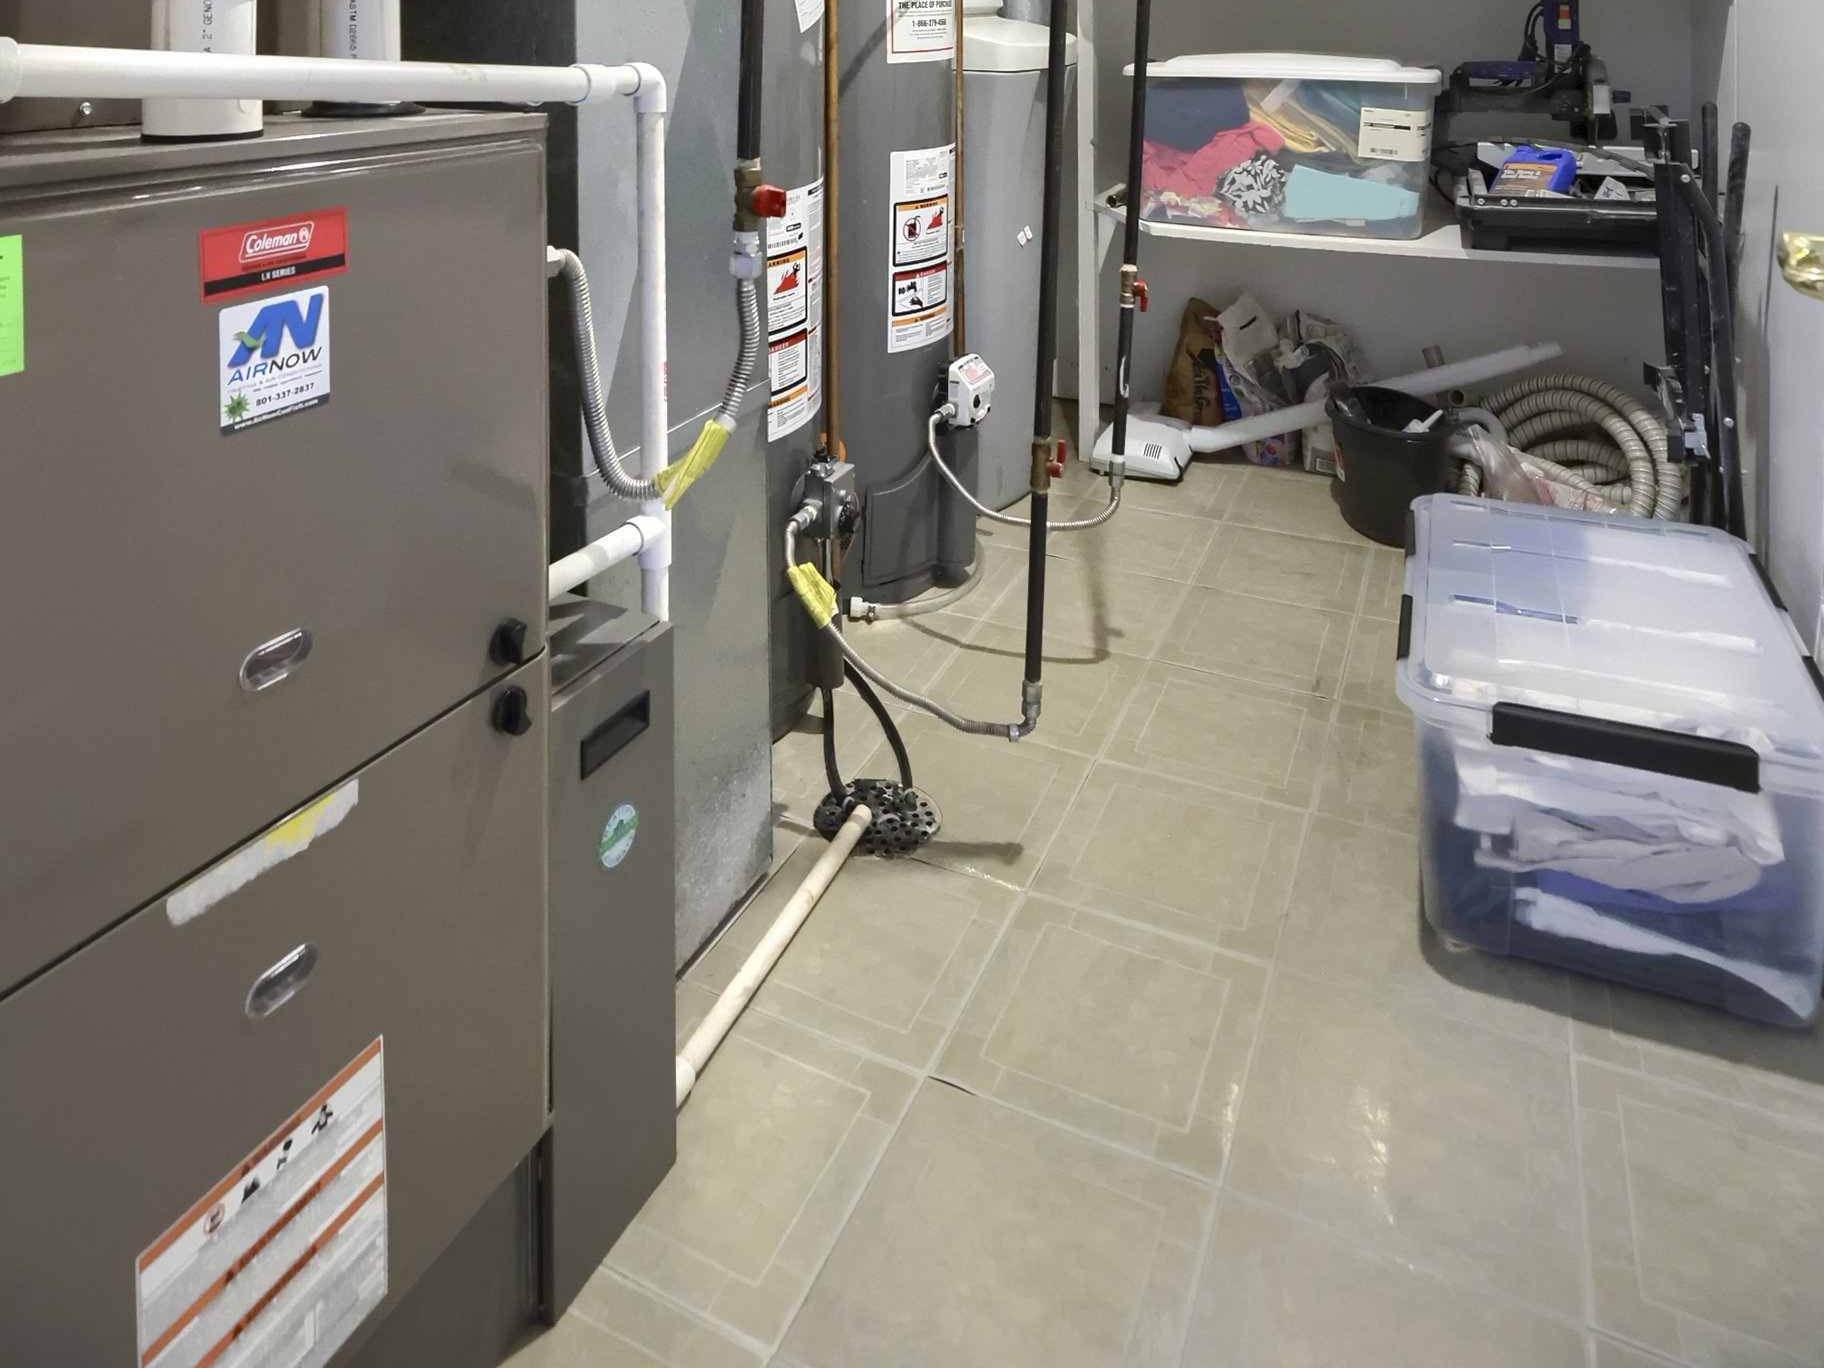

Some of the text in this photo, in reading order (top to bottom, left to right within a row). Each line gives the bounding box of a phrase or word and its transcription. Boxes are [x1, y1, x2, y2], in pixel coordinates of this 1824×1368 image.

[898, 1, 911, 10] THE
[911, 1, 928, 9] PLACE
[929, 0, 935, 8] OF
[245, 232, 298, 254] Coleman
[271, 266, 297, 280] SERIES
[227, 346, 323, 386] AIRNOW
[255, 382, 315, 407] 801-337-2837
